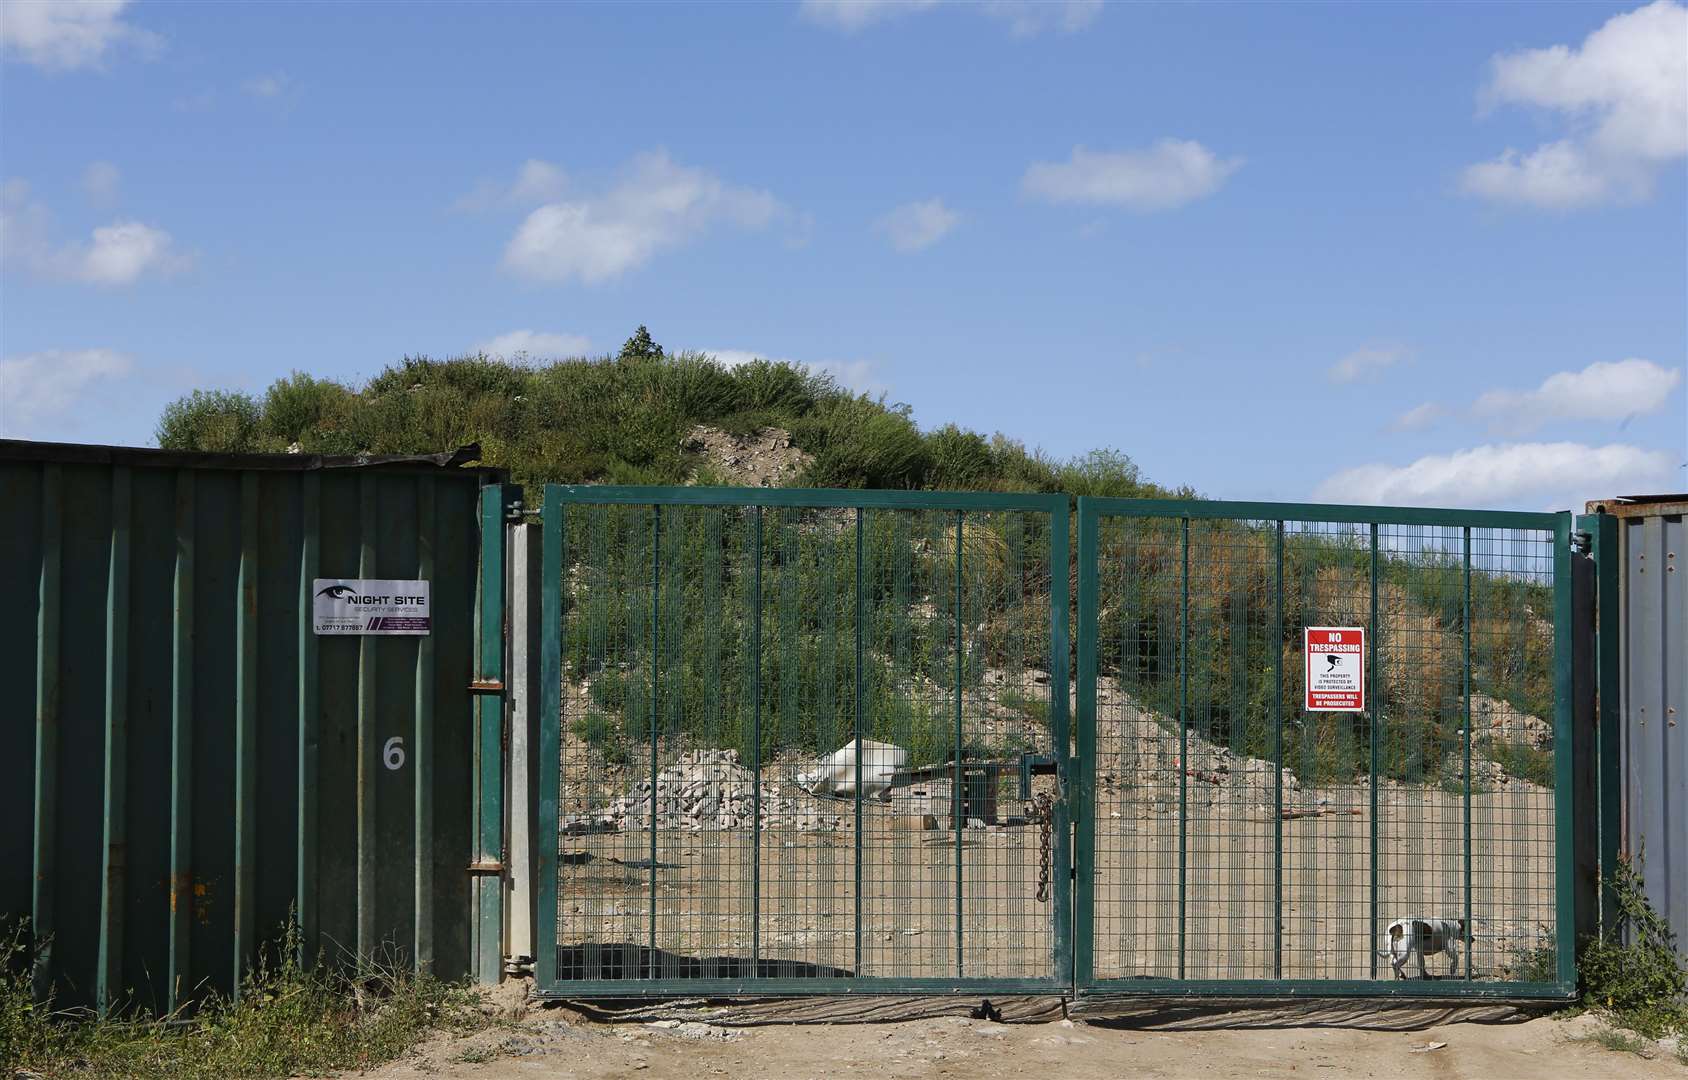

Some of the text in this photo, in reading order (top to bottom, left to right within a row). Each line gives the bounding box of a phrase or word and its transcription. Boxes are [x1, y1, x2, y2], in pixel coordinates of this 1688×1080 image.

[347, 595, 425, 605] NIGHT SITE
[1328, 632, 1342, 642] NO
[1310, 643, 1360, 652] TRESPASSING
[383, 736, 405, 770] 6
